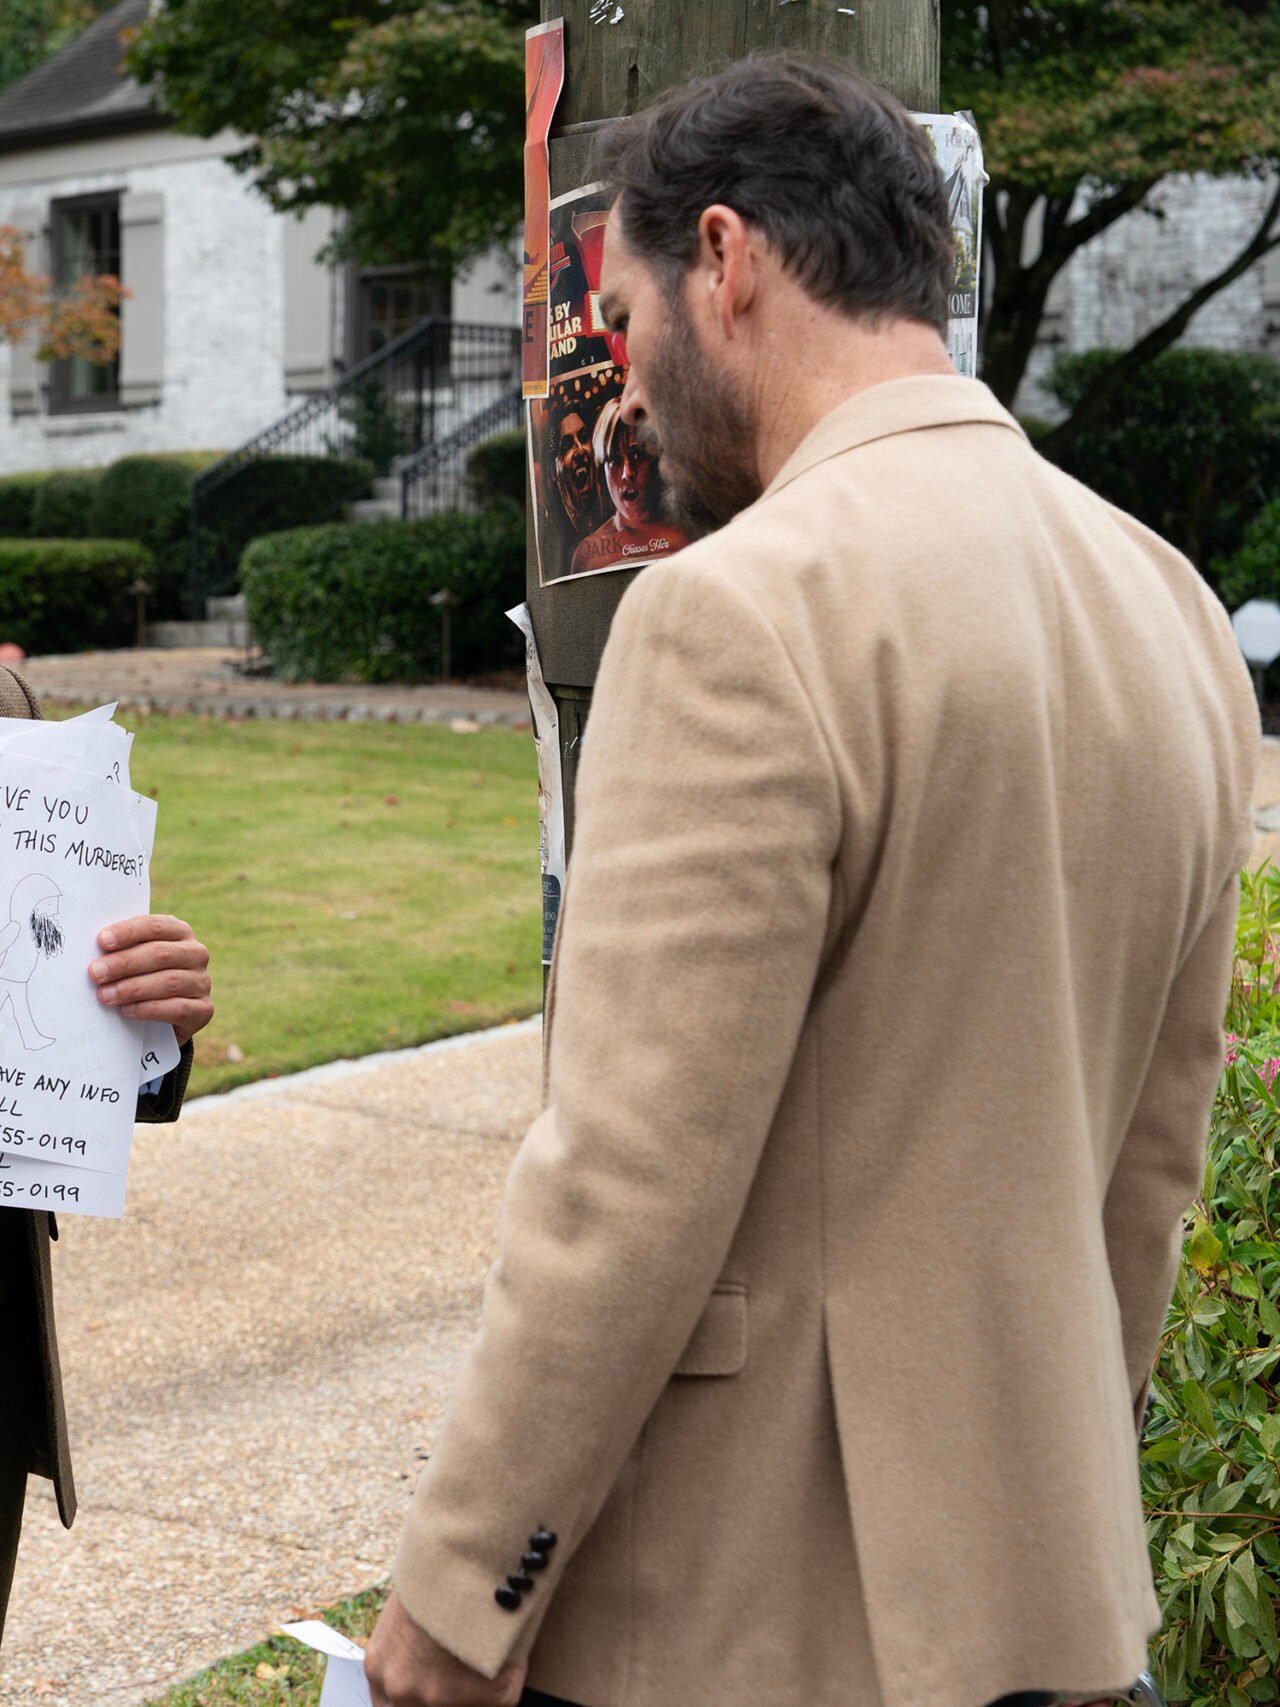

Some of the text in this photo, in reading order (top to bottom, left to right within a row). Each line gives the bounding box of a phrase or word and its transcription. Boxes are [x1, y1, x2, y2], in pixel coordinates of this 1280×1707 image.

[554, 301, 571, 322] BY
[550, 337, 577, 360] AND
[649, 538, 670, 552] Her
[43, 796, 89, 825] YOU
[13, 829, 56, 853] THIS
[64, 839, 144, 886] MURDERER?
[34, 1075, 71, 1100] ANY
[80, 1084, 120, 1104] INFO
